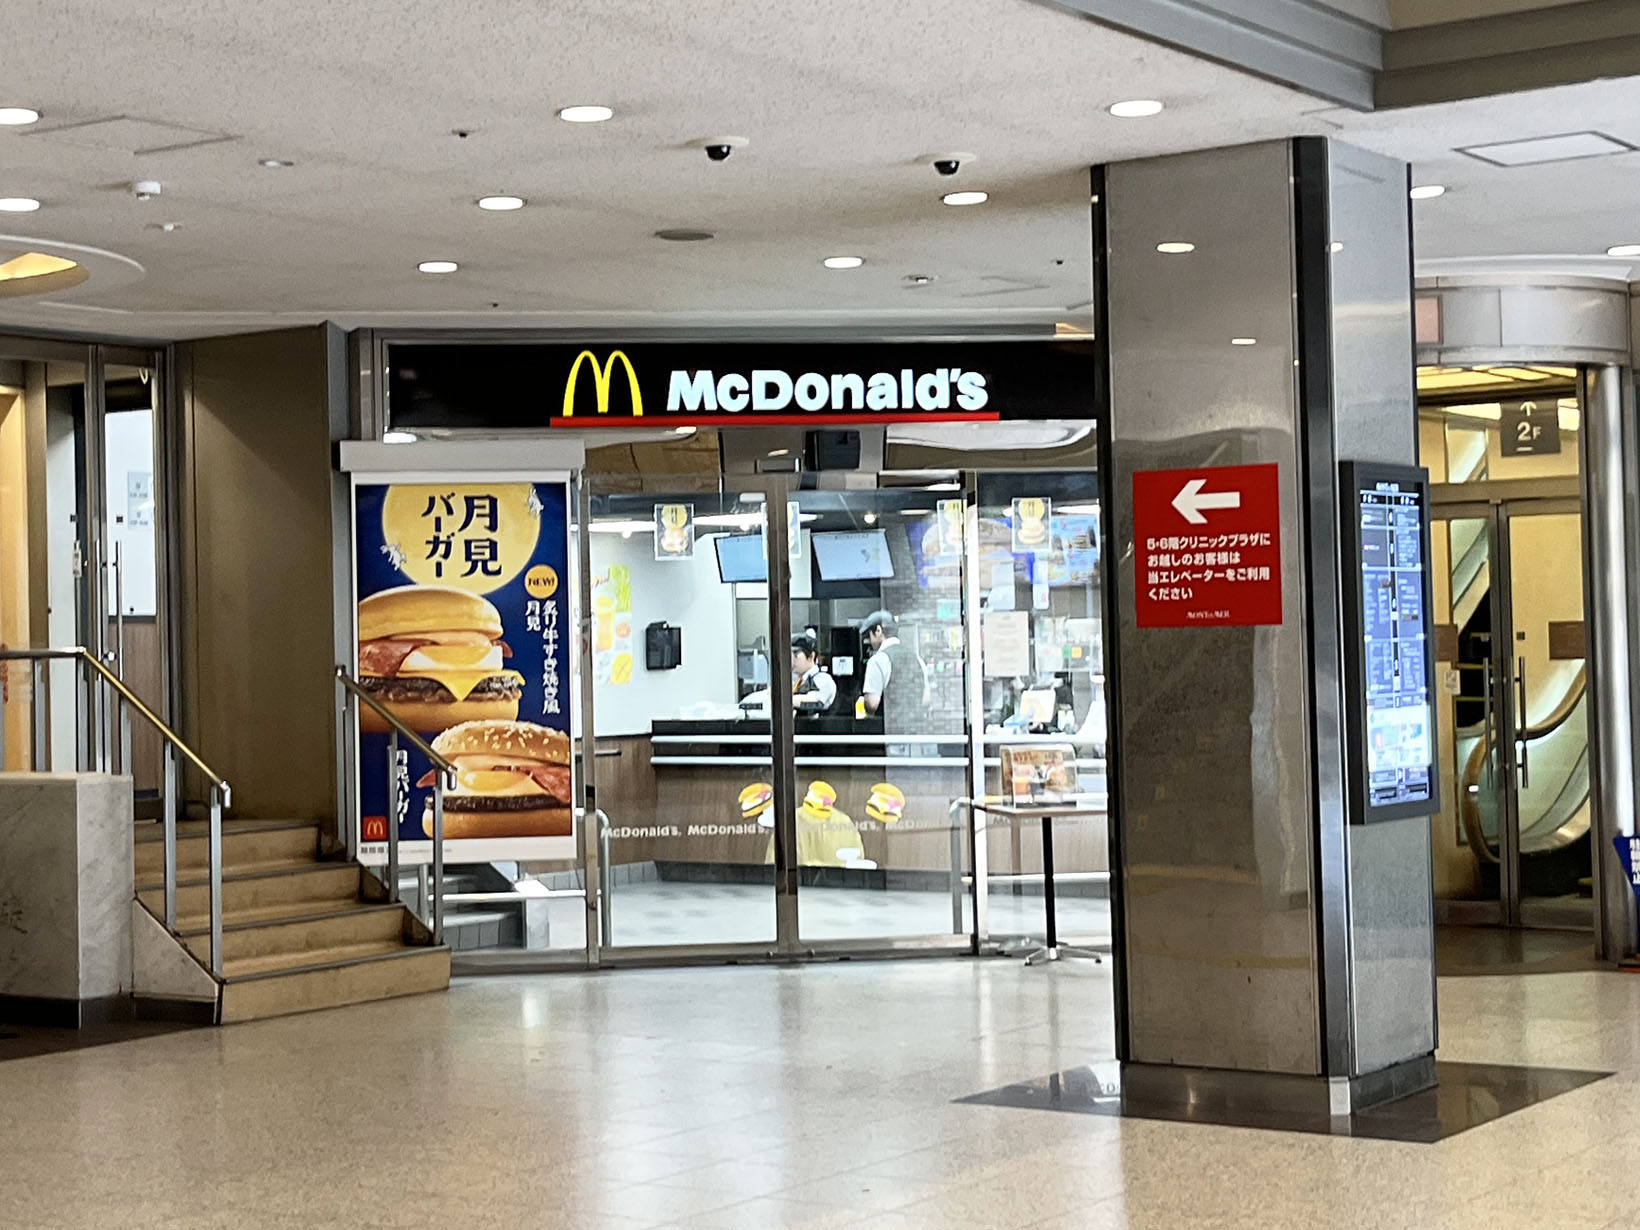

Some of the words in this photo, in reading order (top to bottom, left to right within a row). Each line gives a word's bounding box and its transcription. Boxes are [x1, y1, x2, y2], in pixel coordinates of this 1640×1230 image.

[666, 368, 989, 412] McDonald's
[1517, 421, 1541, 441] 2F
[421, 492, 456, 578] バーガー
[458, 494, 502, 577] 月見
[1147, 551, 1241, 567] お越しのお客様は
[1147, 566, 1270, 585] 当エレベーターをご利用
[1148, 586, 1193, 601] ください
[525, 600, 541, 631] 月見
